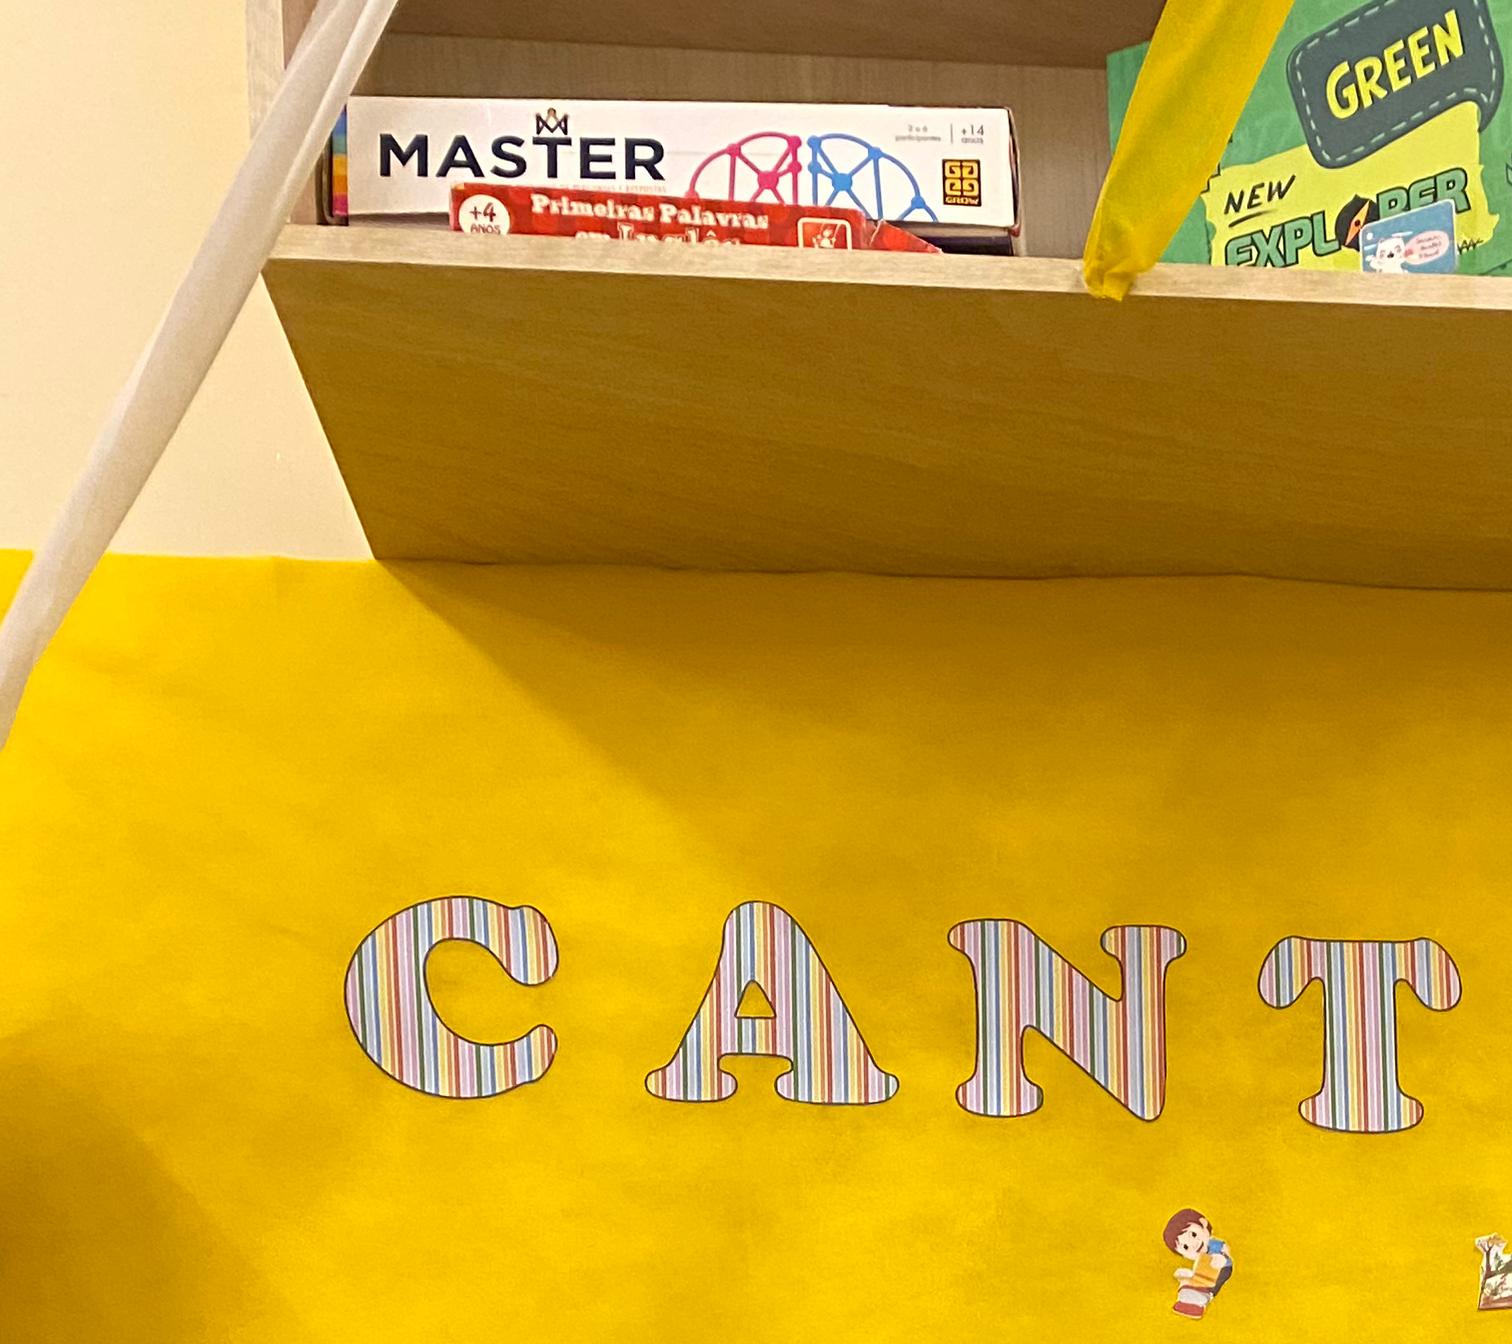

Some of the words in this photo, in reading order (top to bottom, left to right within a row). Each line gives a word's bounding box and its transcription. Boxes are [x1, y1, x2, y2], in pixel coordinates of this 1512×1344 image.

[1325, 9, 1465, 119] GREEN
[379, 133, 667, 182] MASTER
[469, 201, 497, 223] +4
[530, 193, 655, 222] Primeiras
[659, 202, 770, 230] Palavras
[945, 196, 980, 205] GROW
[1224, 174, 1296, 215] NEW
[470, 223, 501, 234] ANOS
